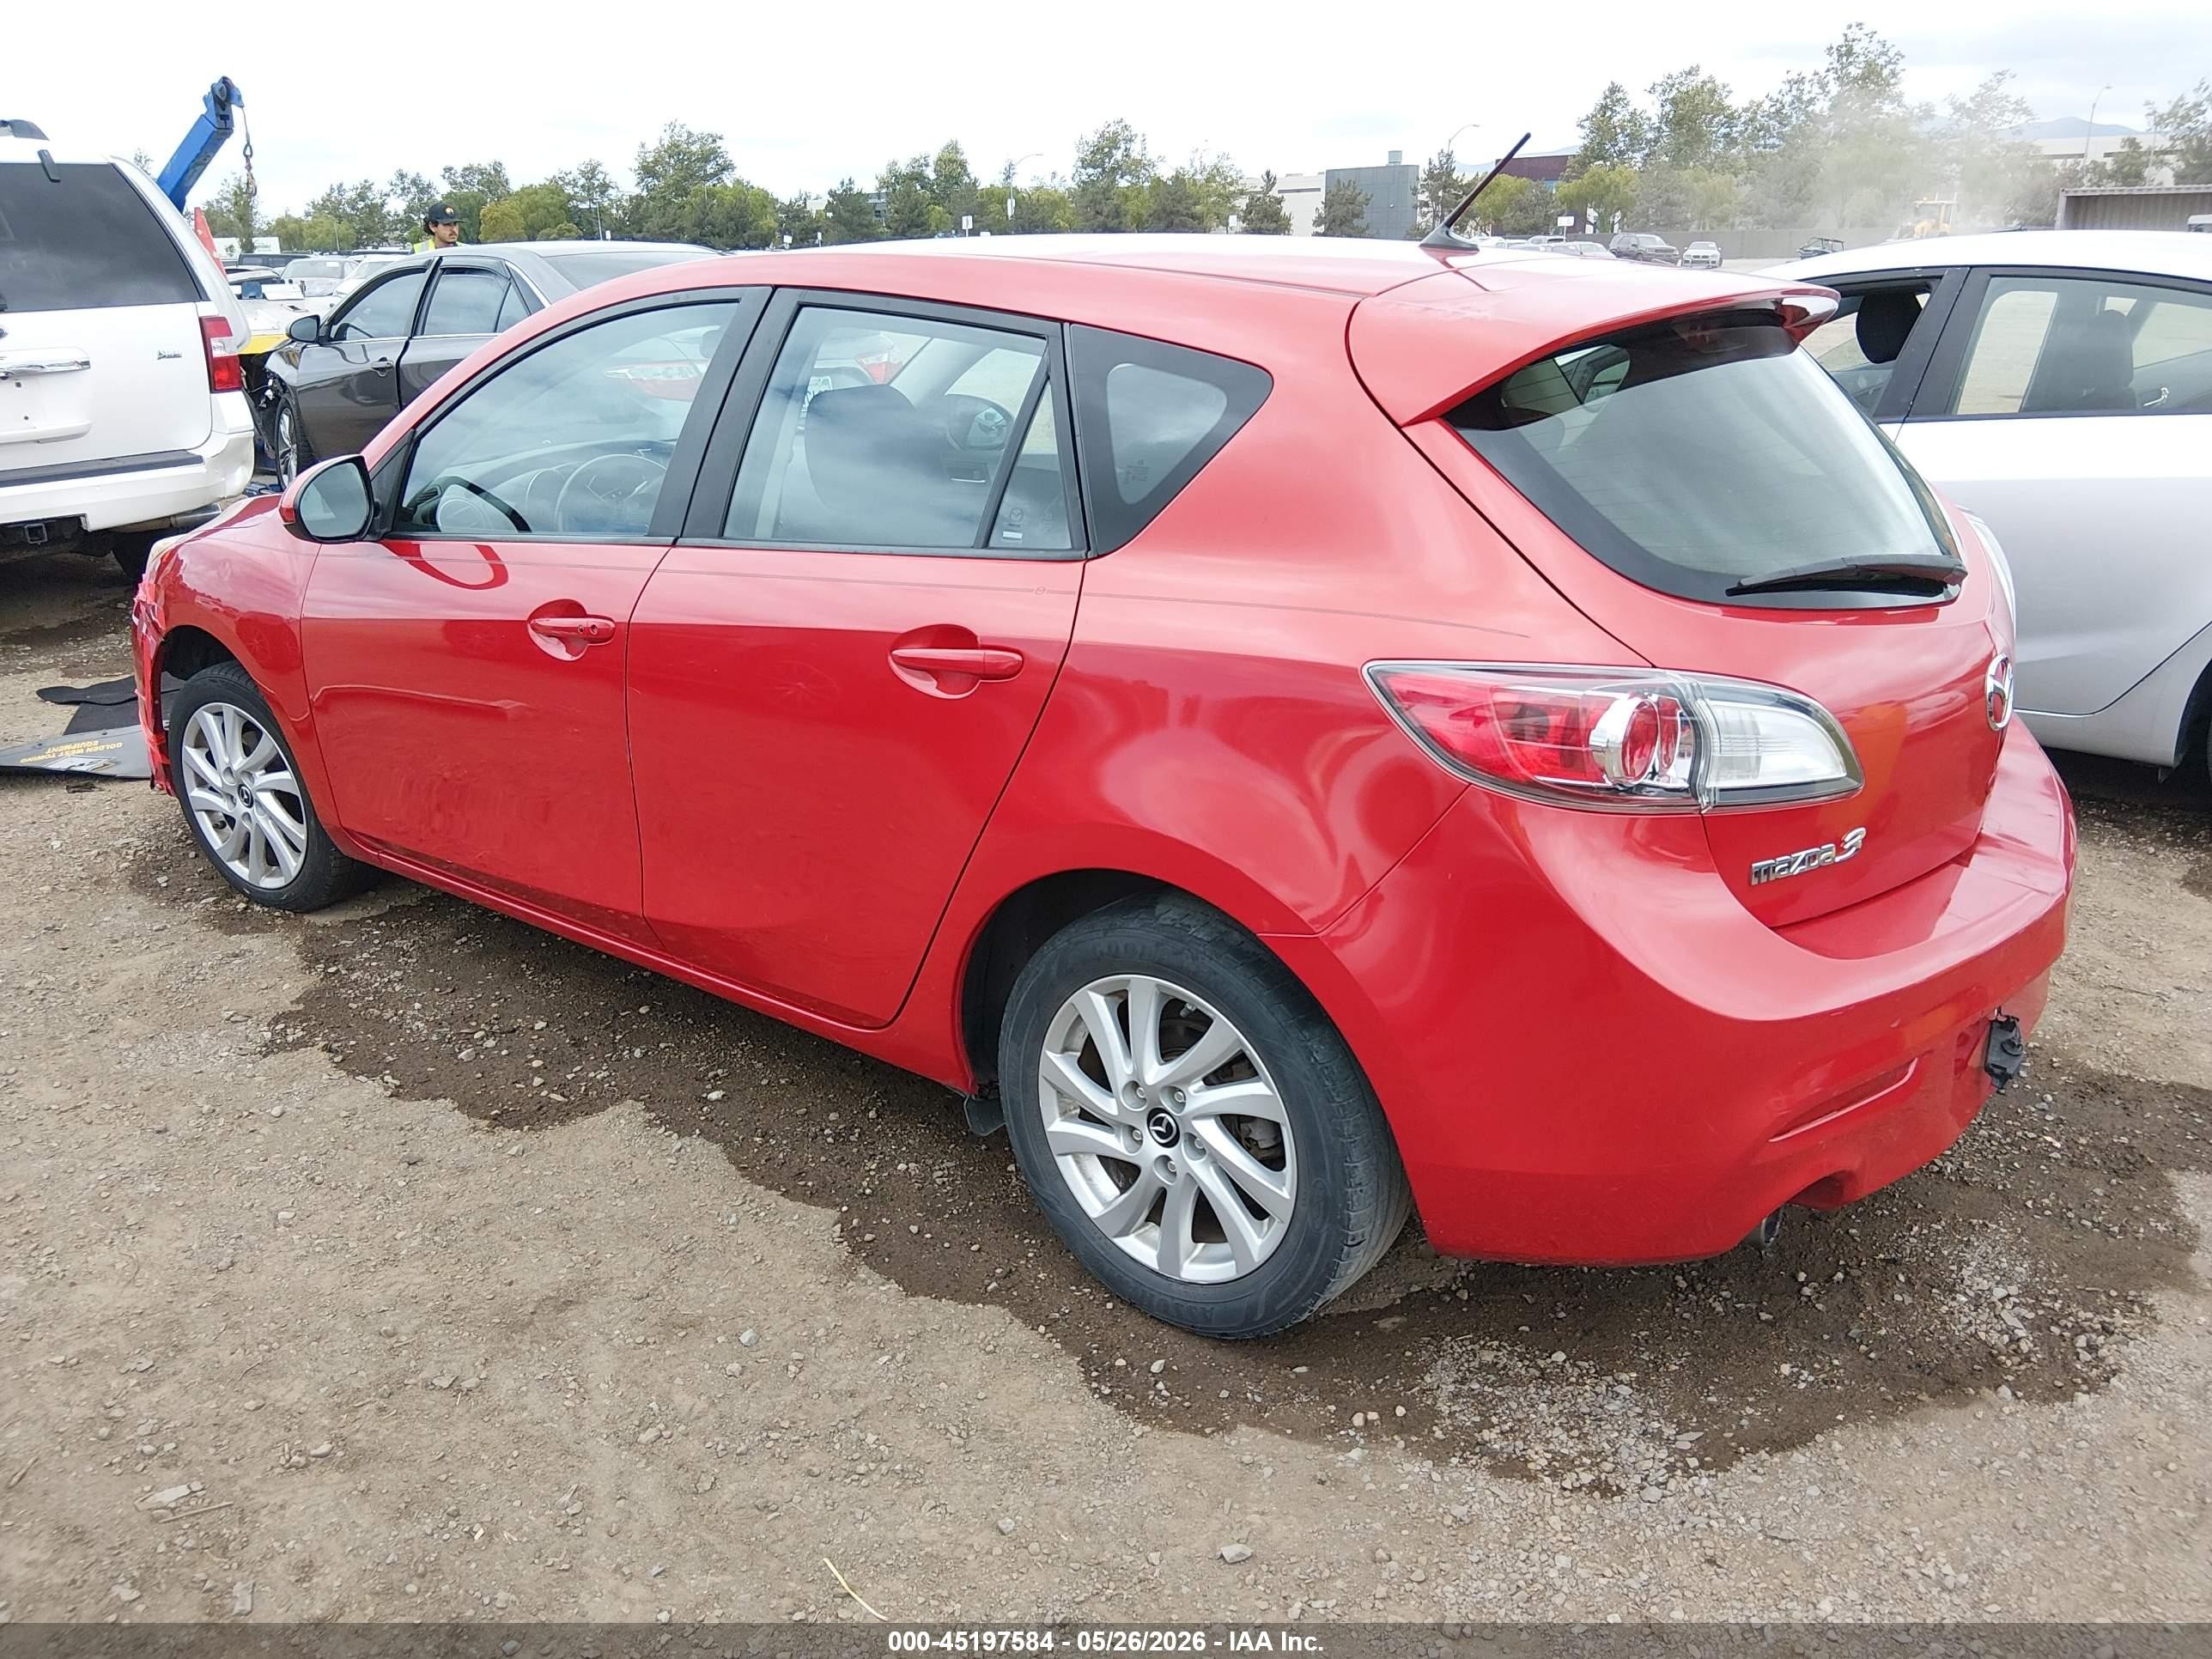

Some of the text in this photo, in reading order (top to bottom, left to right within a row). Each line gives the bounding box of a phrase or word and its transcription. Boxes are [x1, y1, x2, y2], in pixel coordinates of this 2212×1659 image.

[20, 742, 123, 763] GOLDEN WEST TOWING
[46, 740, 99, 754] EQUIPMENT
